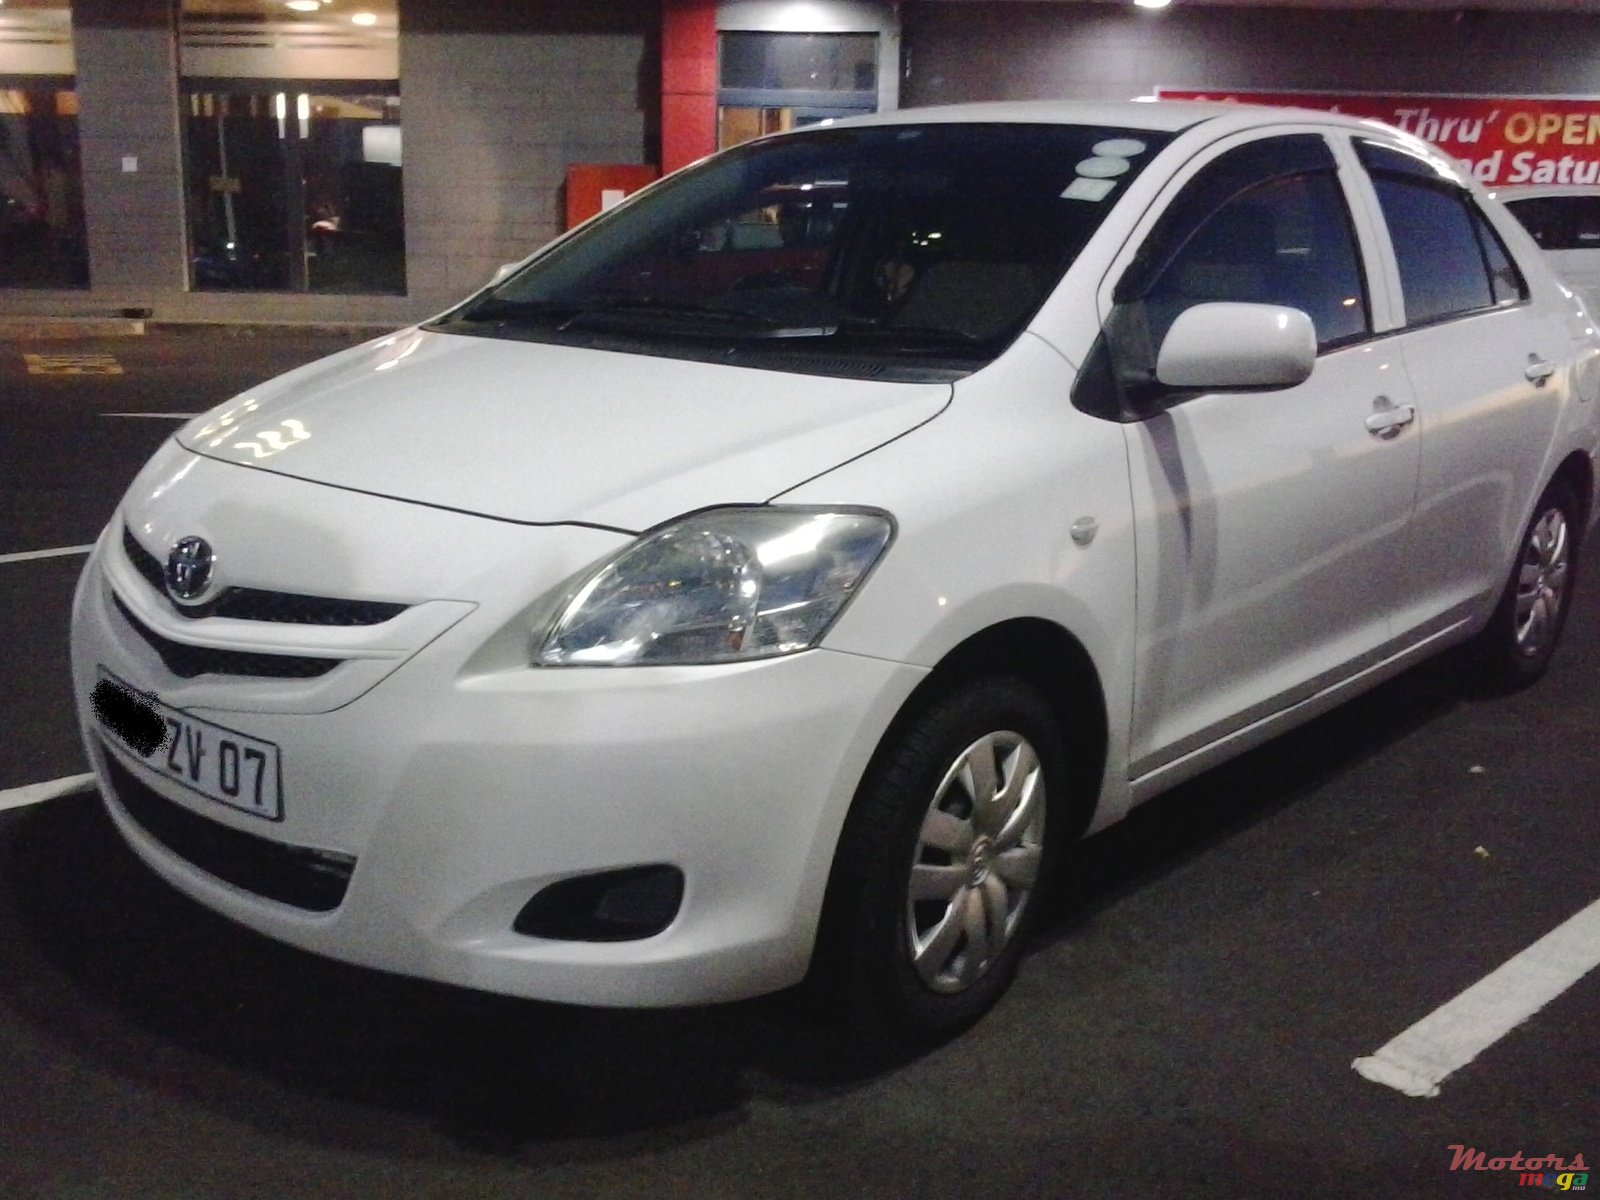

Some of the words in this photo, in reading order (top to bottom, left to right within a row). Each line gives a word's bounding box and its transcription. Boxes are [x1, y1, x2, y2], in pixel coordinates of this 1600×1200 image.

[1507, 151, 1600, 184] Satu
[166, 717, 204, 781] ZV
[219, 740, 267, 805] 07
